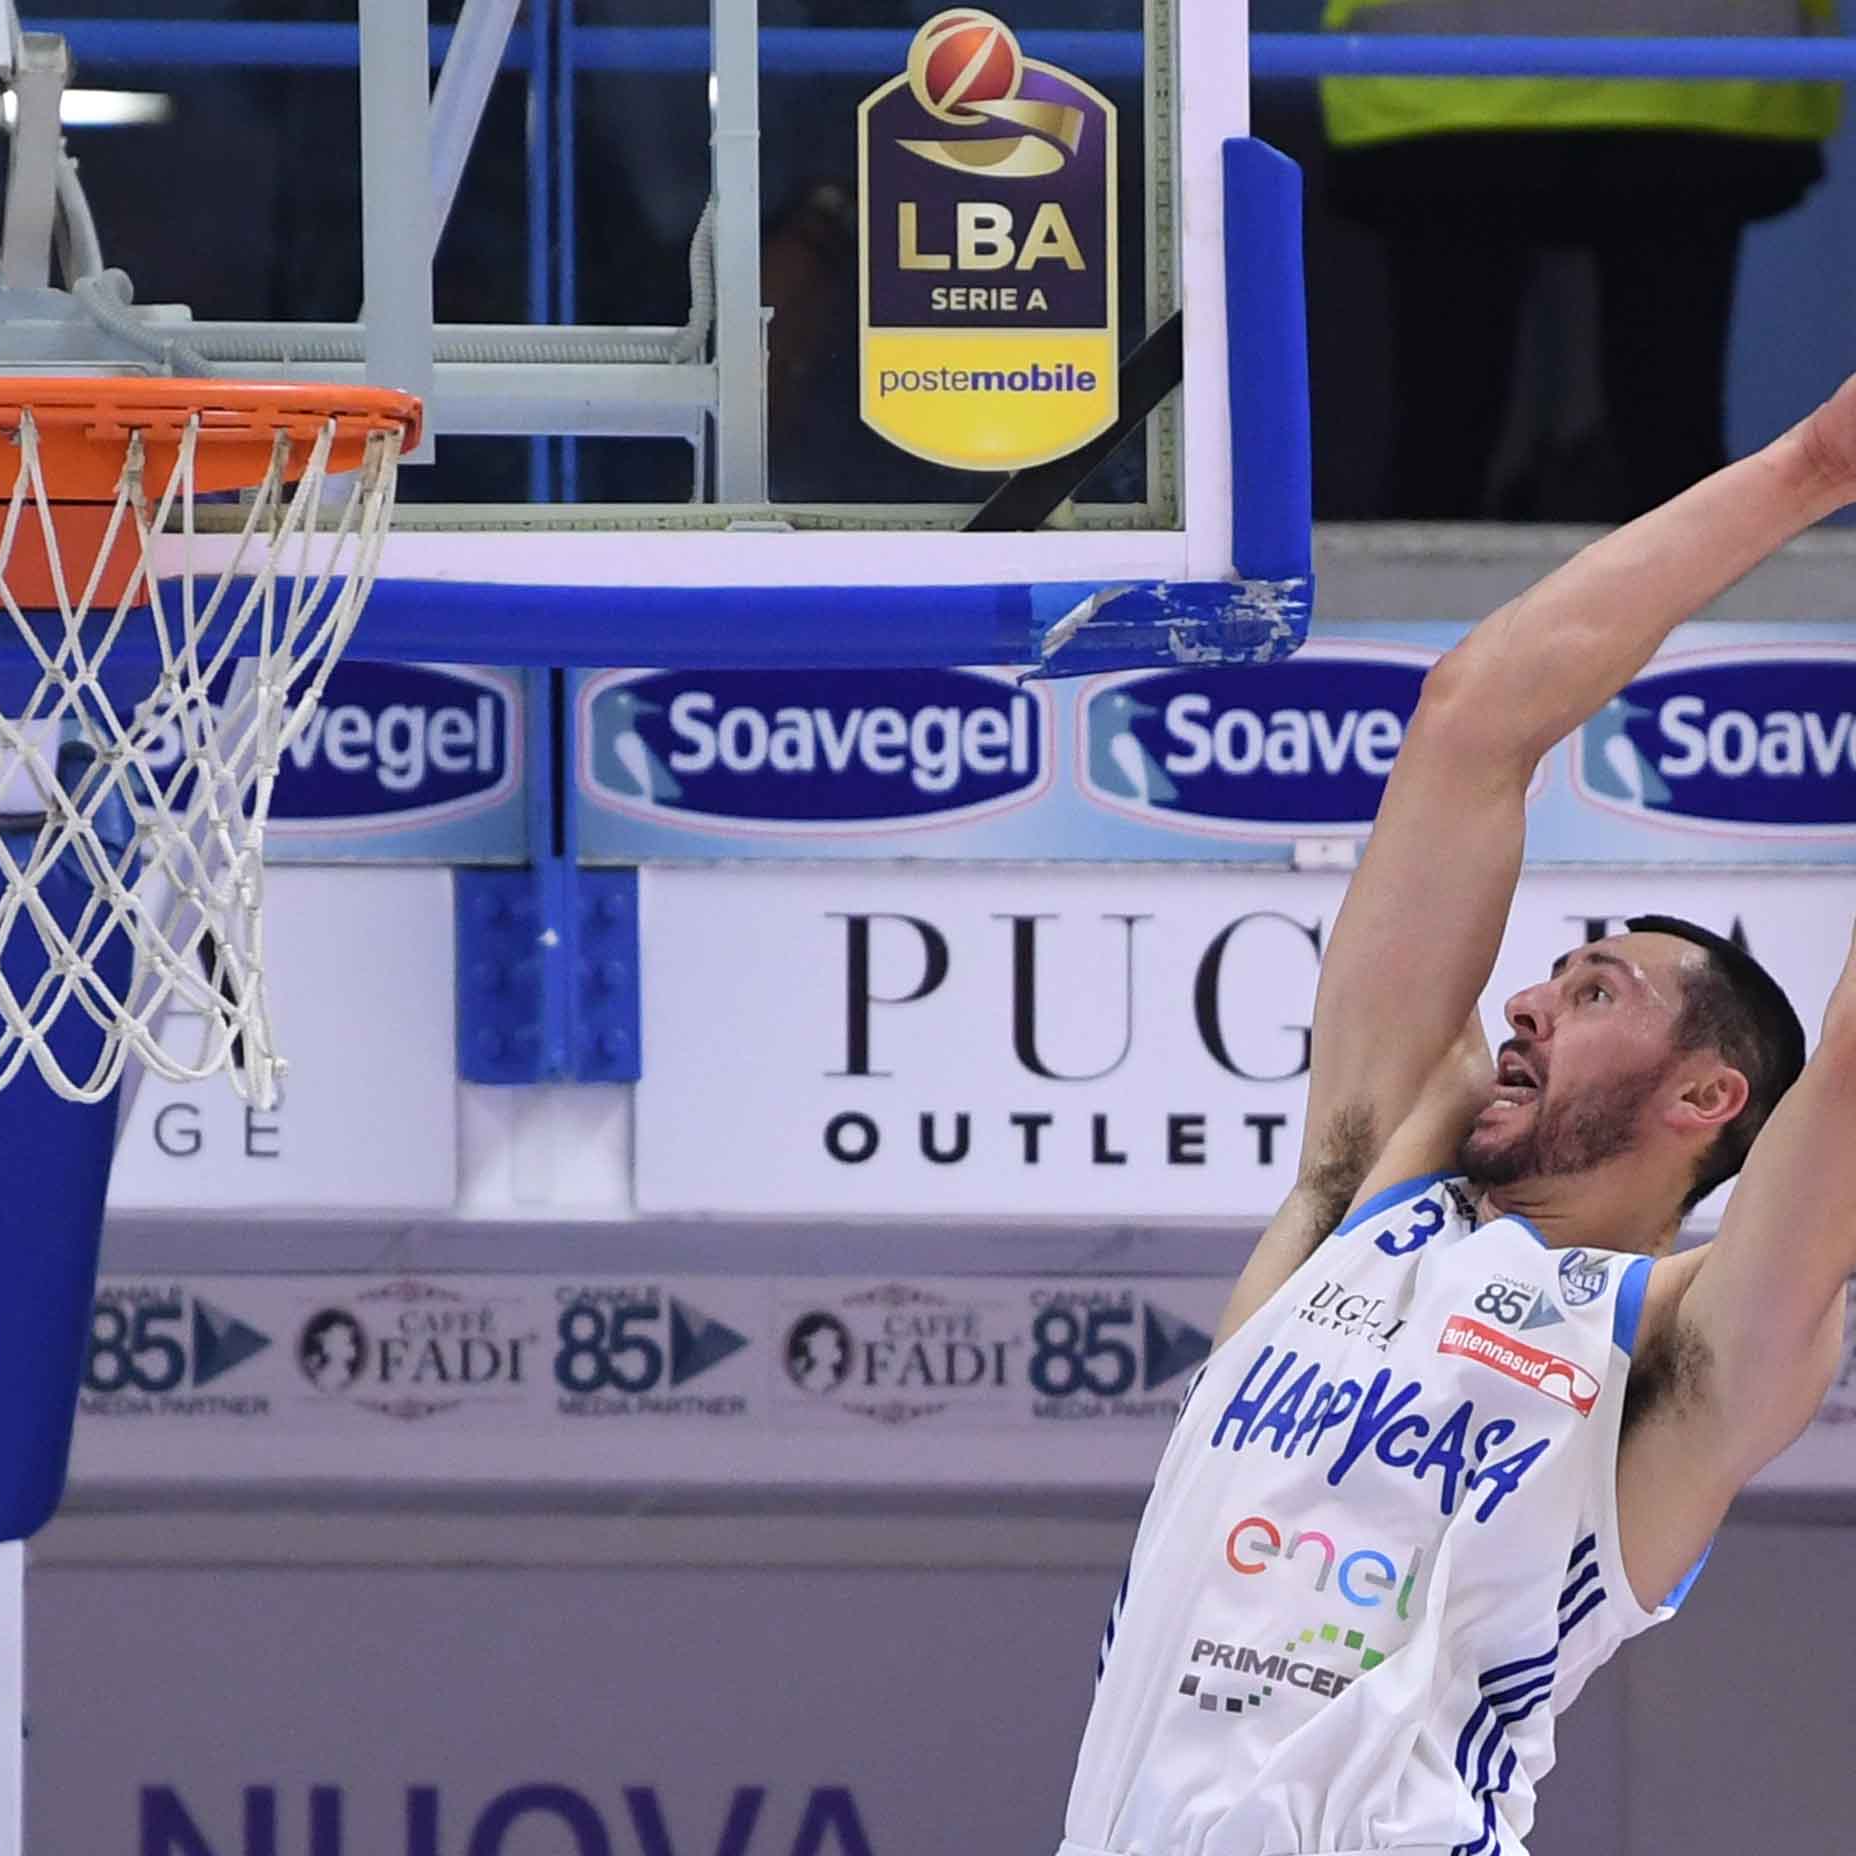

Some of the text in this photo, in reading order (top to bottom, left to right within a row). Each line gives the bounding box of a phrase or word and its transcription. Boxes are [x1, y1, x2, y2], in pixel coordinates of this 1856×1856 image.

[896, 201, 1087, 272] LBA
[931, 289, 1049, 312] SERIE A
[879, 363, 1097, 396] postemobile
[668, 691, 1028, 792] Soavegel
[1164, 693, 1405, 775] Soave
[824, 911, 1326, 1083] PUG
[1375, 1200, 1446, 1257] 3
[100, 1284, 183, 1302] ANALE
[1309, 1280, 1408, 1343] UGLI
[1474, 1282, 1532, 1325] 85
[82, 1302, 186, 1392] 85
[377, 1336, 527, 1384] FADI
[553, 1302, 664, 1393] 85
[862, 1340, 1009, 1387] FADI
[1028, 1305, 1137, 1397] 85
[1442, 1326, 1549, 1381] antennasud
[1225, 1516, 1424, 1620] enel
